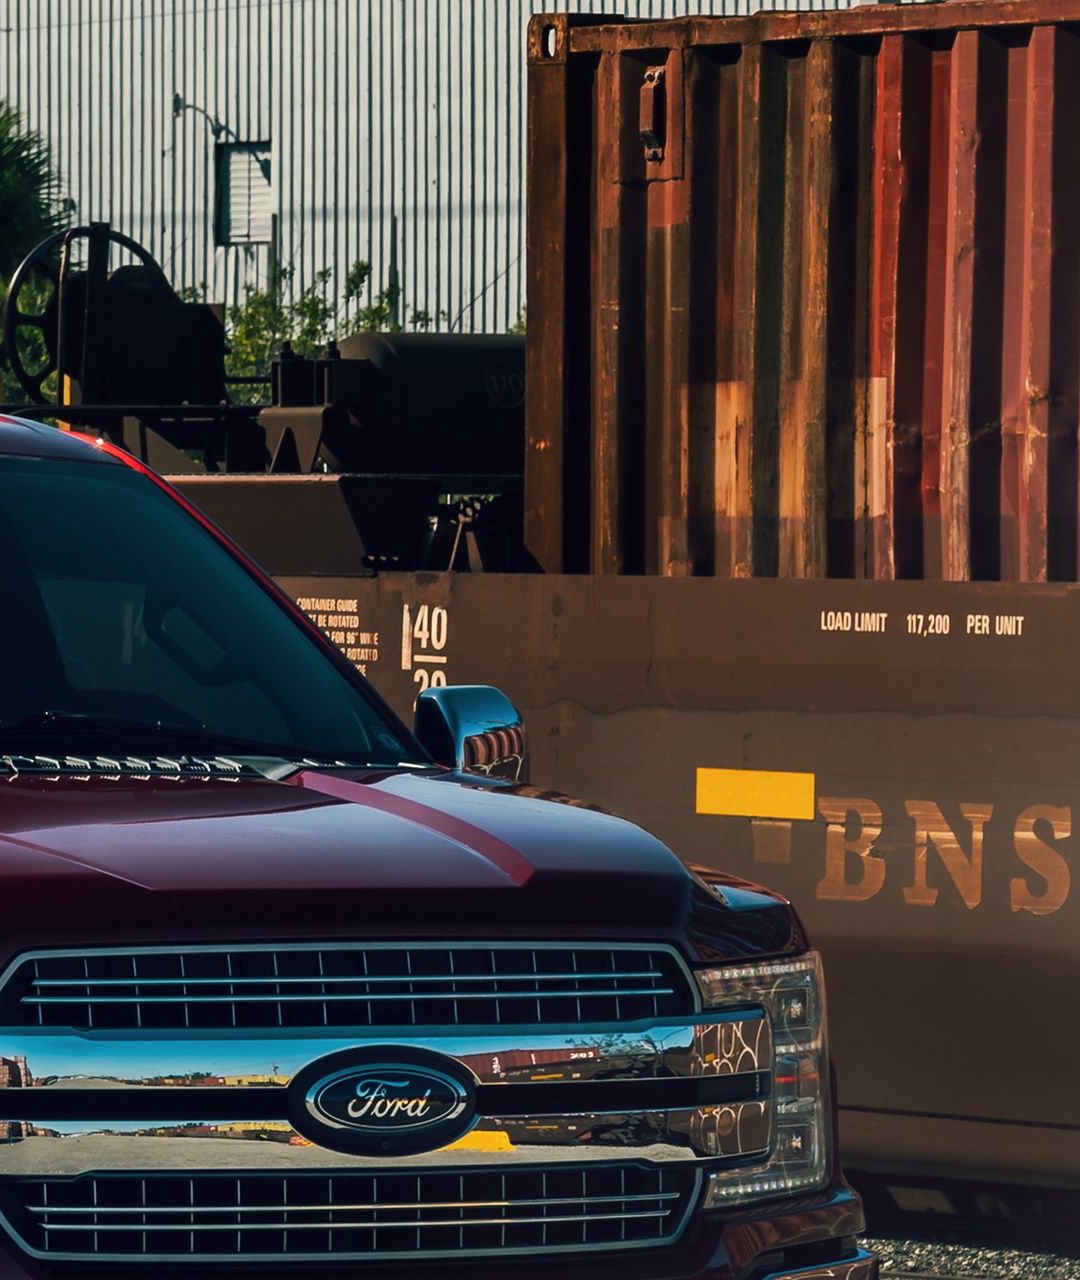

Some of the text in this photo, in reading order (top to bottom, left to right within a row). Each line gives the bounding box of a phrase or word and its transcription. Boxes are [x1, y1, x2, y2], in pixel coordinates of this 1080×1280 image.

[488, 374, 523, 392] 110
[336, 599, 358, 612] GUIDE
[317, 615, 327, 627] BE
[328, 615, 359, 629] ROTATED
[413, 604, 448, 650] 40
[821, 611, 1024, 637] LOAD LIMIT 117,200 PER UNIT
[816, 796, 1072, 915] BNS
[347, 1079, 432, 1118] Ford
